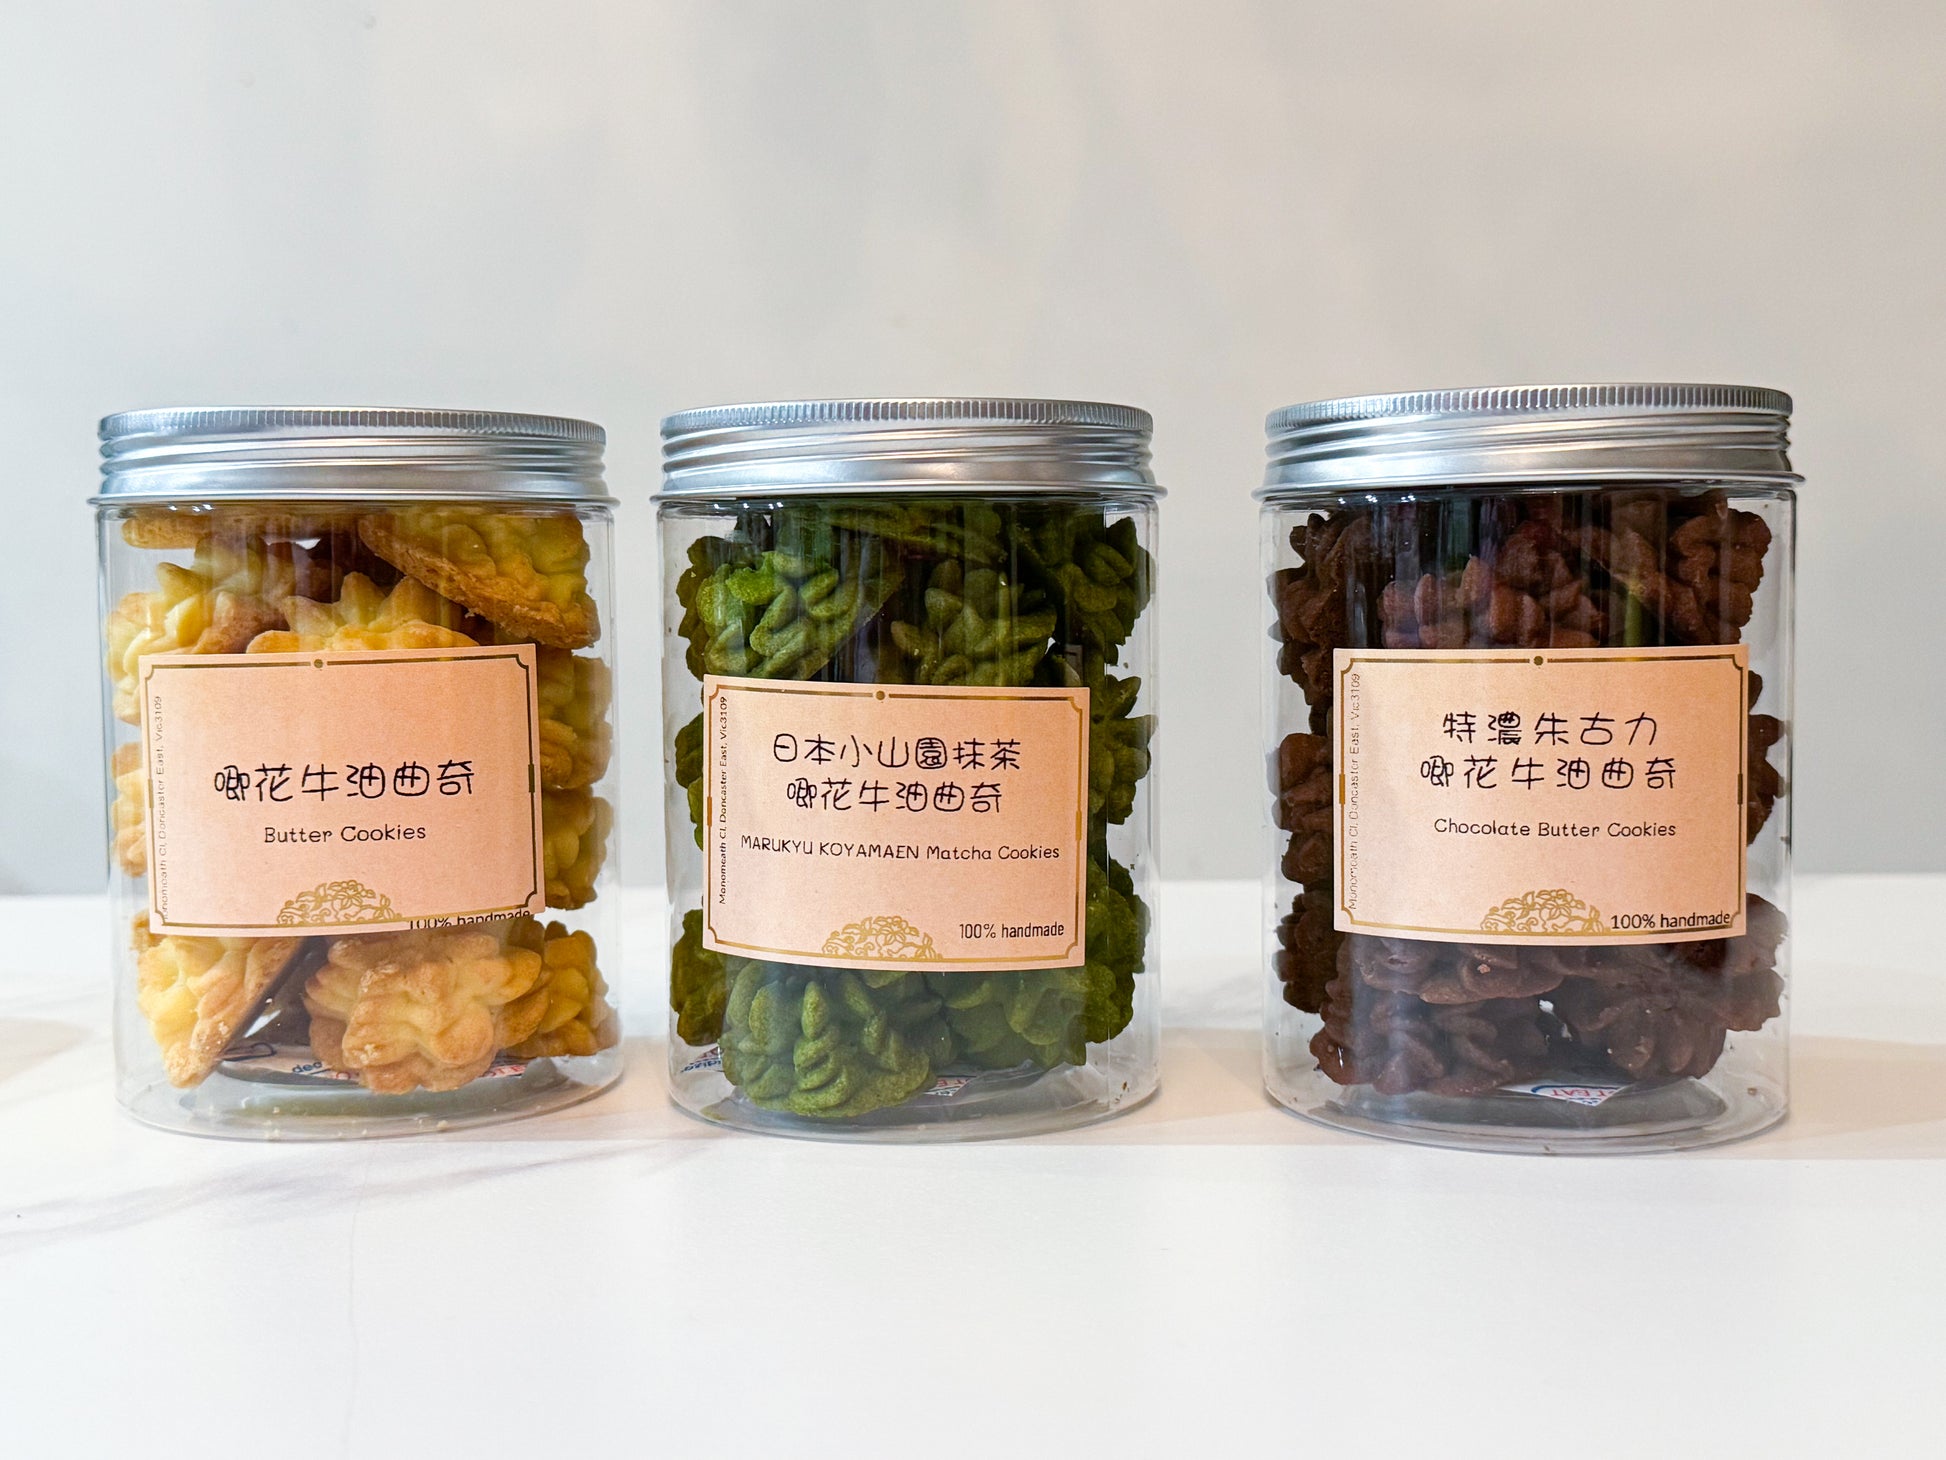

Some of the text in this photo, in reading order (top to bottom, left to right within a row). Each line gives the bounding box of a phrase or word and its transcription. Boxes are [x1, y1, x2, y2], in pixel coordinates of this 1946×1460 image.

[1349, 673, 1361, 721] Vic3109
[719, 695, 728, 740] Vic3109
[1442, 711, 1658, 746] 特濃朱古力
[773, 733, 1021, 770] 日本小山園抹茶
[719, 770, 727, 823] Doncaster
[1348, 759, 1359, 820] Doncaster
[156, 779, 167, 840] Doncaster
[264, 823, 427, 844] Butter Cookies
[1433, 818, 1677, 838] Chocolate Butter Cookies
[740, 834, 1061, 861] MARUKYU KOYAMAEN Matcha Cookies
[718, 842, 727, 905] Monomeath
[409, 917, 453, 930] 100%
[959, 921, 1065, 939] 100% handmade
[1610, 910, 1731, 930] 100% handmade
